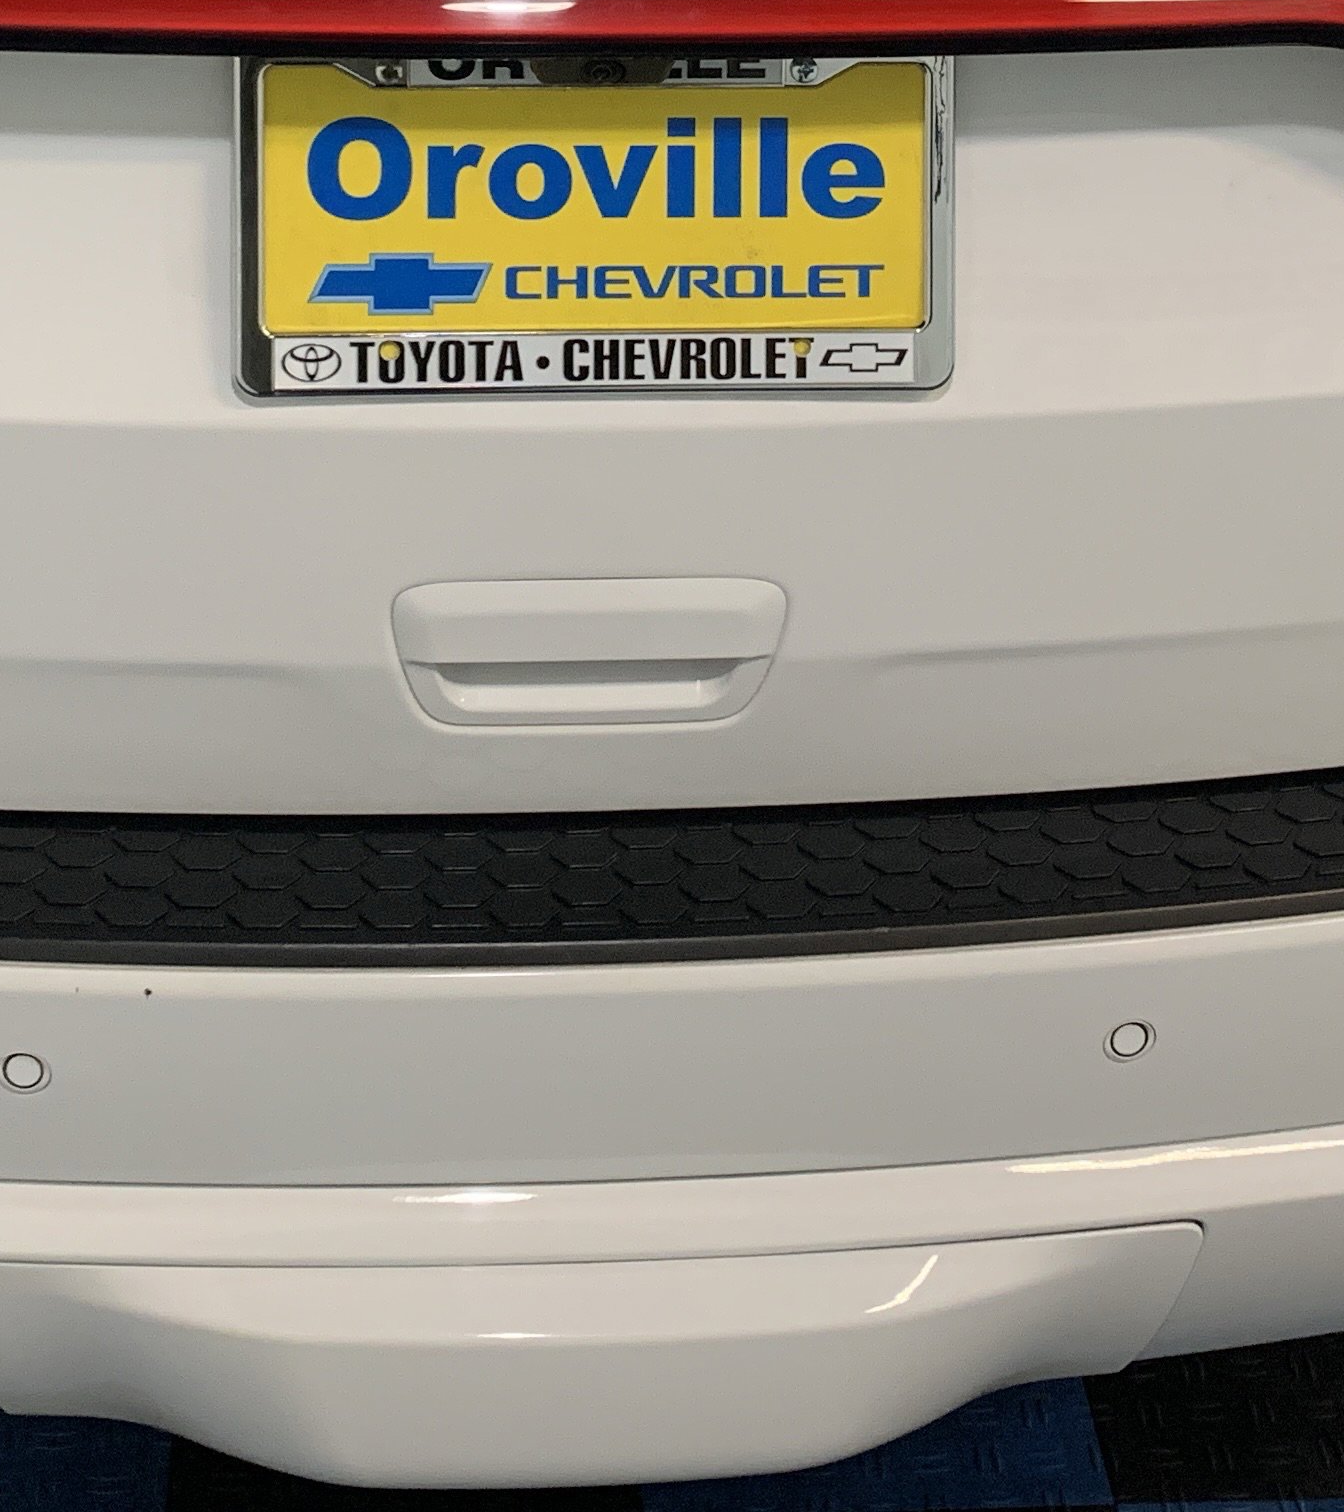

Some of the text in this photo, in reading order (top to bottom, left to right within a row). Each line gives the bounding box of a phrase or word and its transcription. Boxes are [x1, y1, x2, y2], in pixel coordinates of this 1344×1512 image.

[307, 117, 886, 221] Oroville
[505, 264, 885, 300] CHEVROLET
[349, 338, 814, 383] TOYOTA CHEVROLET
